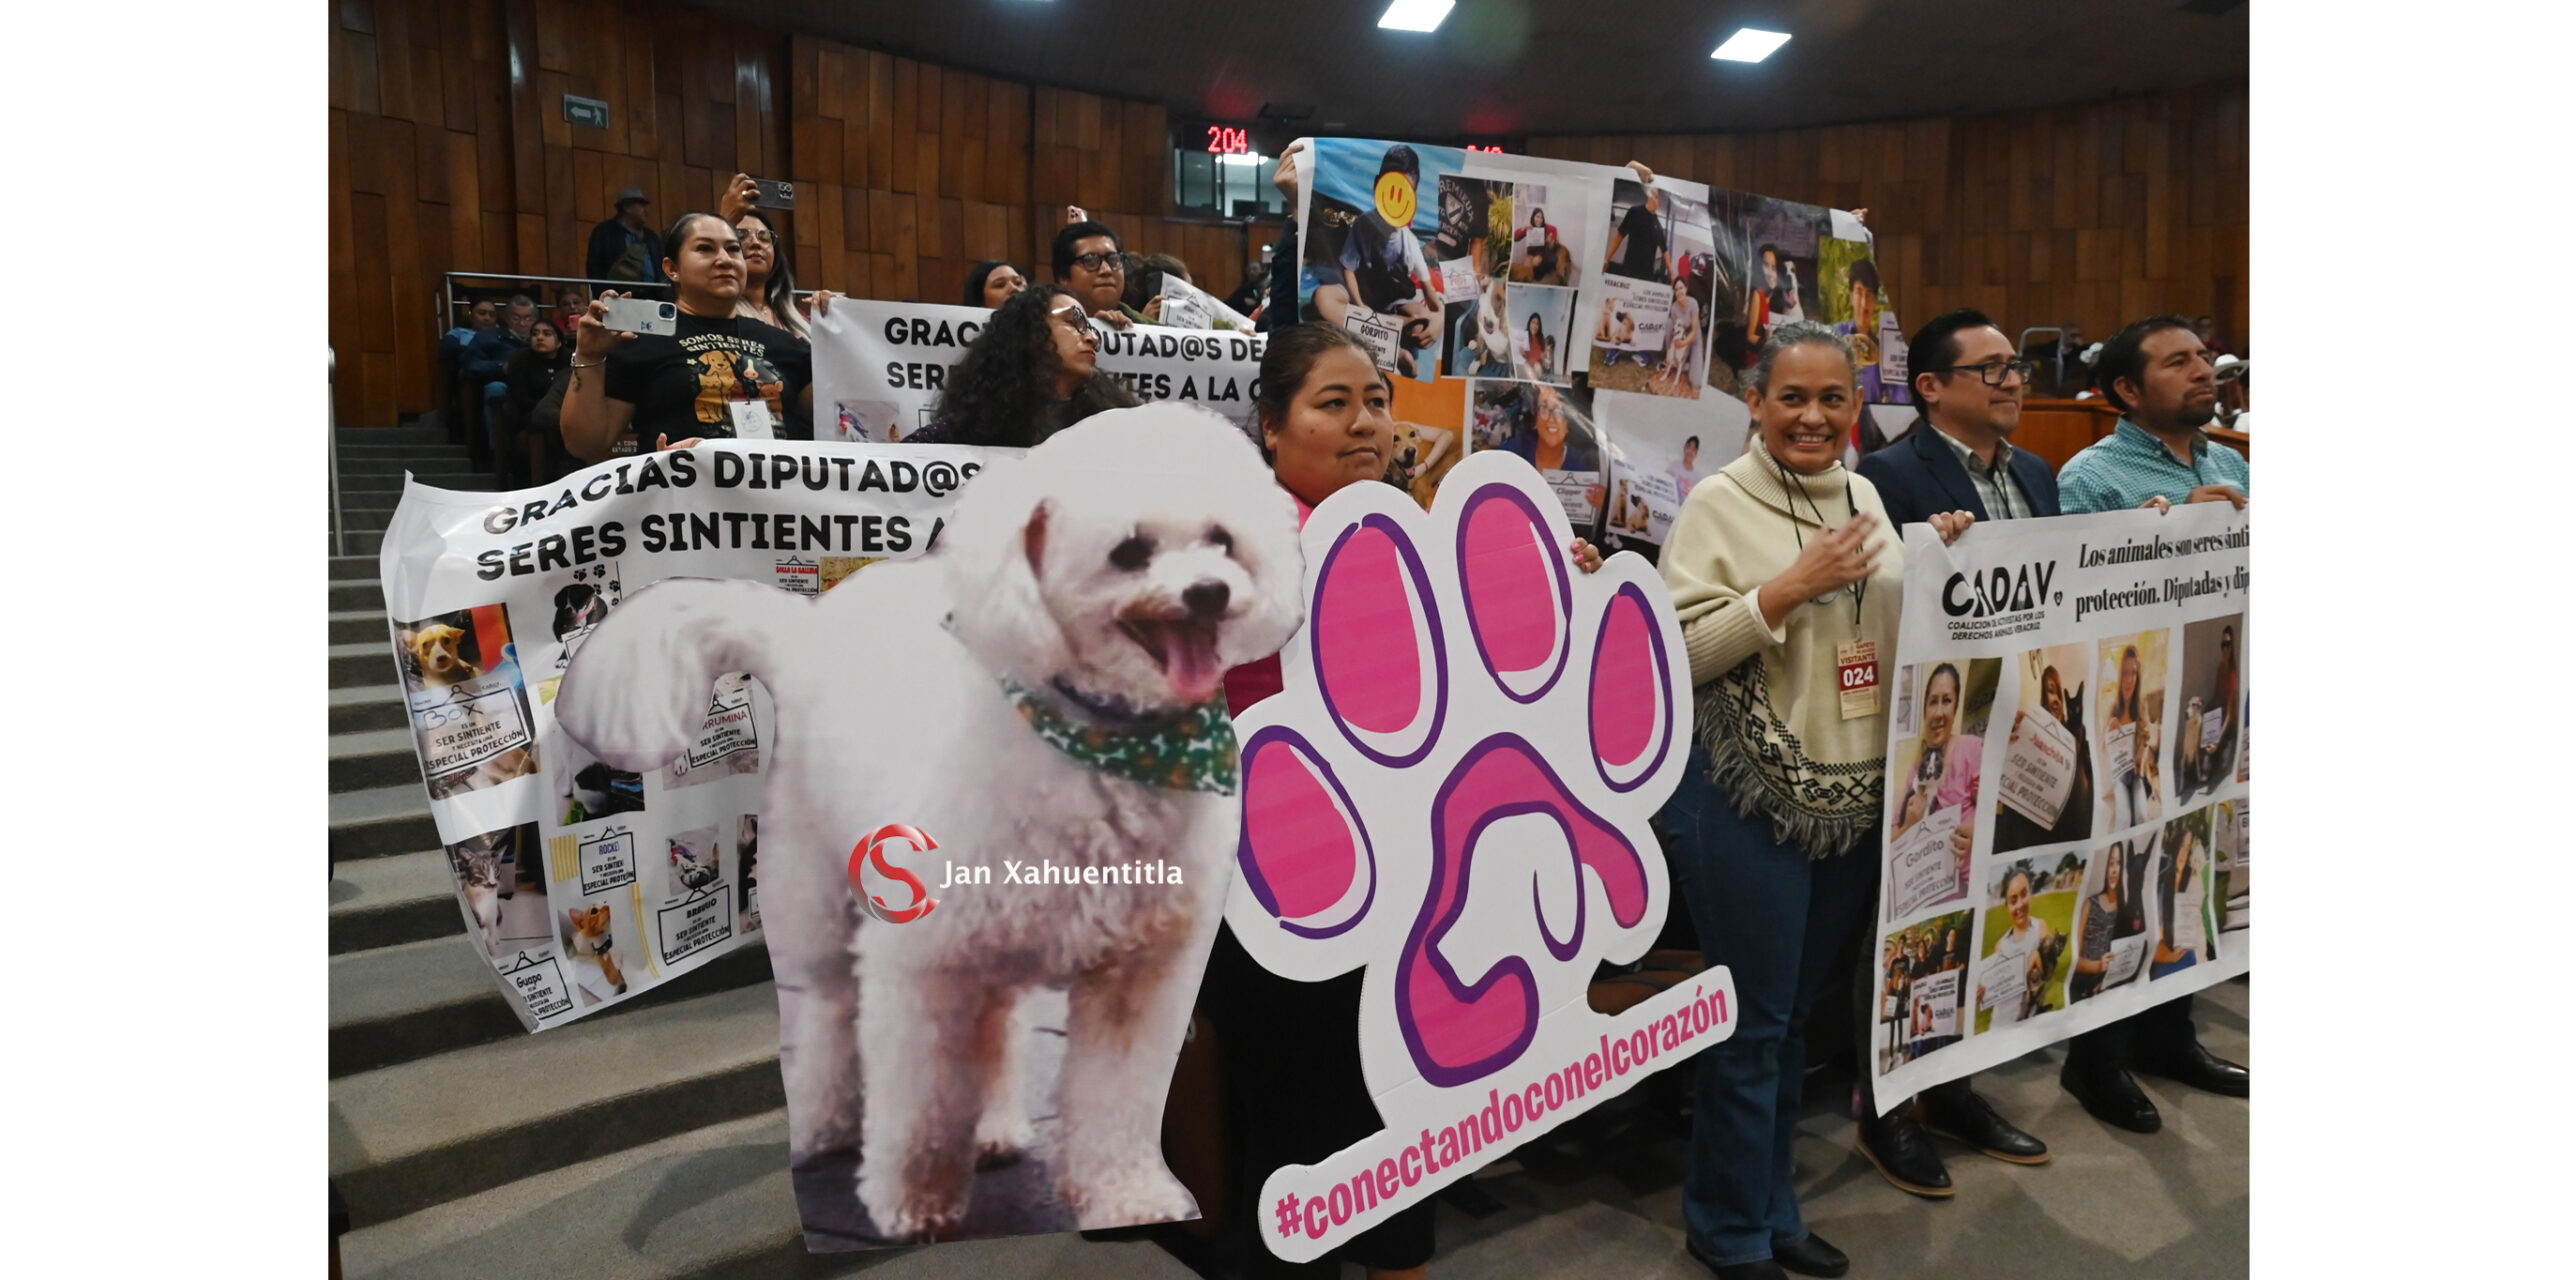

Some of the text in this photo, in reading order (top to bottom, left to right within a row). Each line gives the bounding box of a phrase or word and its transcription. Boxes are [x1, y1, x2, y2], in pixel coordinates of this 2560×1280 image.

[1208, 126, 1248, 154] 204
[679, 333, 724, 346] SOMOS
[1178, 375, 1199, 400] A
[1207, 376, 1240, 401] LA
[483, 450, 697, 534] GRACIAS
[475, 522, 627, 581] SERES
[641, 512, 912, 553] SINTIENTES
[2079, 543, 2106, 568] Los
[2107, 535, 2172, 565] animales
[2193, 534, 2222, 553] seres
[2076, 580, 2161, 622] protección.
[2163, 570, 2222, 607] Diputadas
[2022, 613, 2034, 622] POR
[1952, 630, 1993, 641] DERECHOS
[2014, 622, 2041, 633] VERACRUZ
[1840, 652, 1876, 665] VISITANTE
[1843, 665, 1875, 687] 024
[435, 720, 502, 748] SER SINTIENTE
[700, 738, 712, 747] SER
[712, 729, 741, 743] SINTIENTE
[424, 730, 523, 771] ESPECIAL PROTECCIÓN
[691, 749, 719, 763] ESPECIAL
[719, 738, 756, 754] PROTECCIÓN
[1905, 840, 1944, 868] Gordito
[592, 864, 603, 874] SER
[583, 880, 609, 891] ESPECIAL
[663, 942, 693, 960] ESPECIAL
[693, 925, 730, 947] PROTECCIÓN
[676, 930, 688, 941] SER
[516, 973, 542, 988] Guapo
[1275, 985, 1728, 1240] #conectandoconelcorazón
